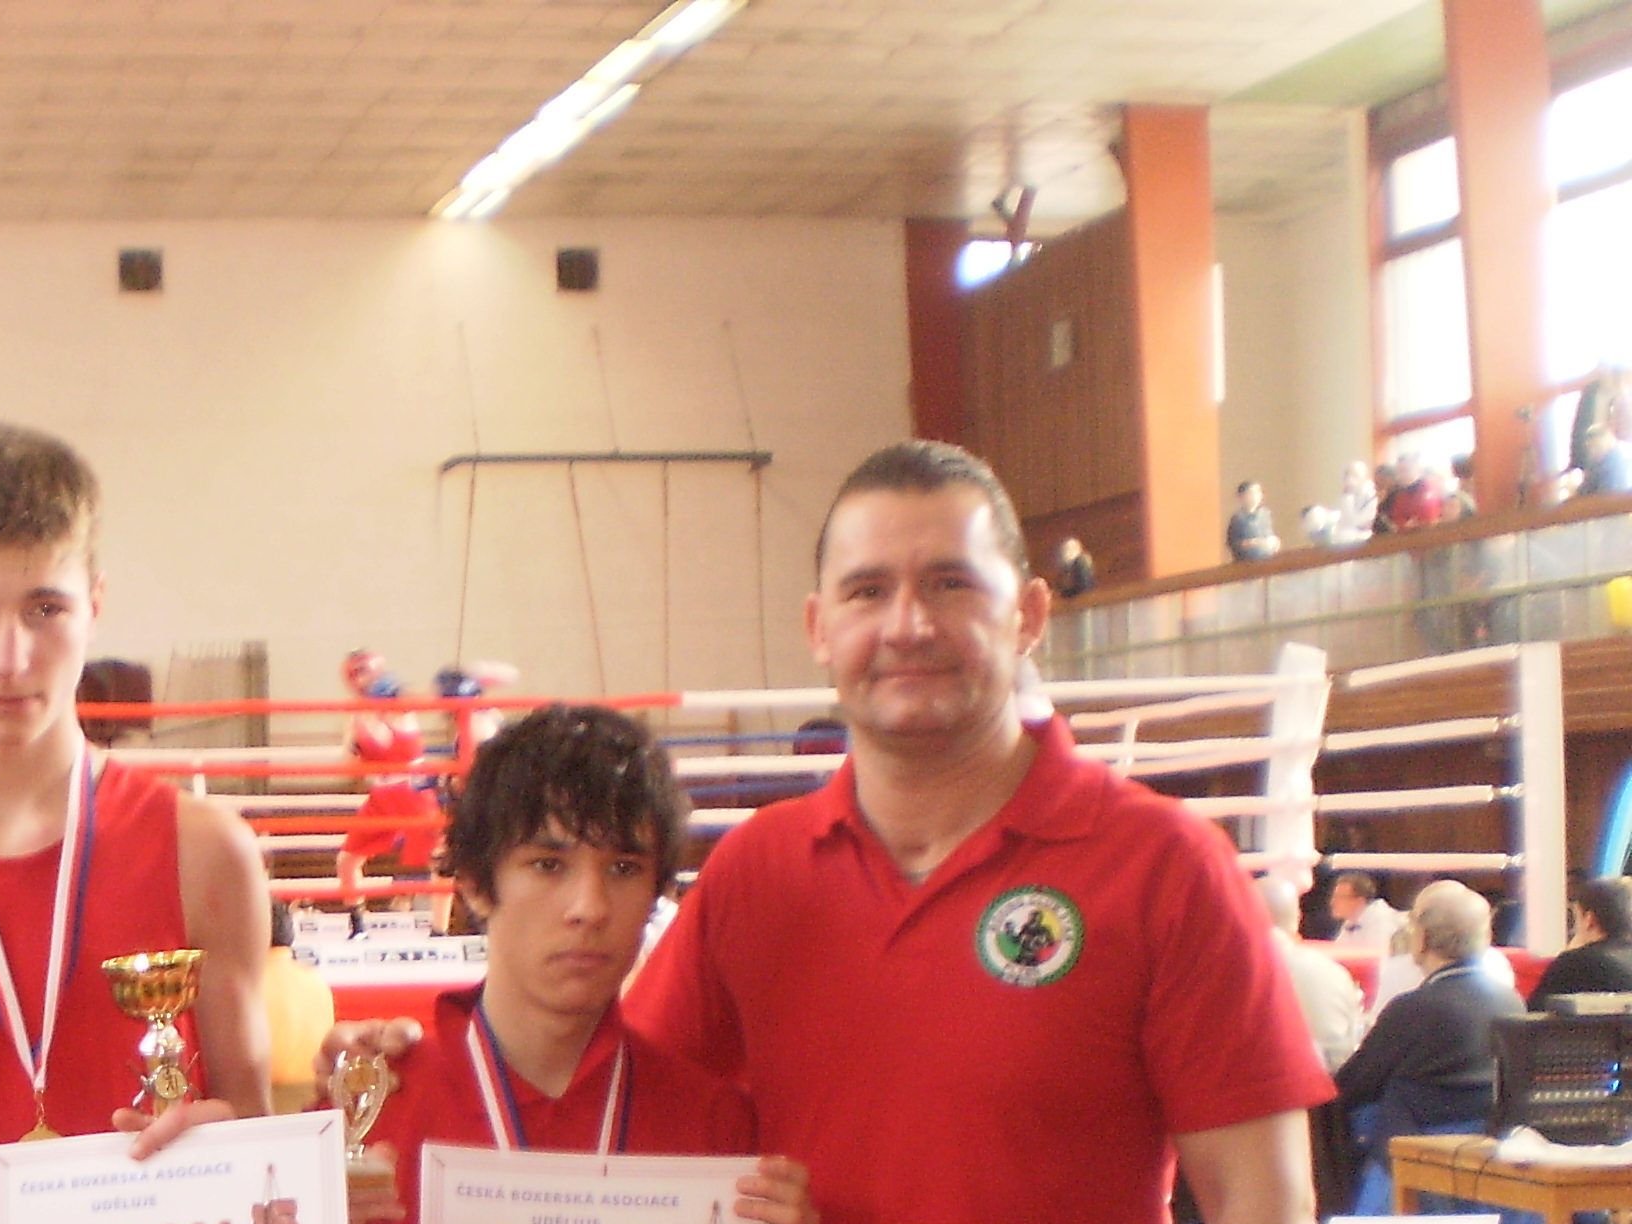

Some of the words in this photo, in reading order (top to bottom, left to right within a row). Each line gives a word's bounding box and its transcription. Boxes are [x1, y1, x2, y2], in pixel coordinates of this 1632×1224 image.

[154, 1162, 234, 1180] ASOCIACE
[456, 1183, 505, 1200] ČESKÁ
[601, 1194, 681, 1208] ASOCIACE
